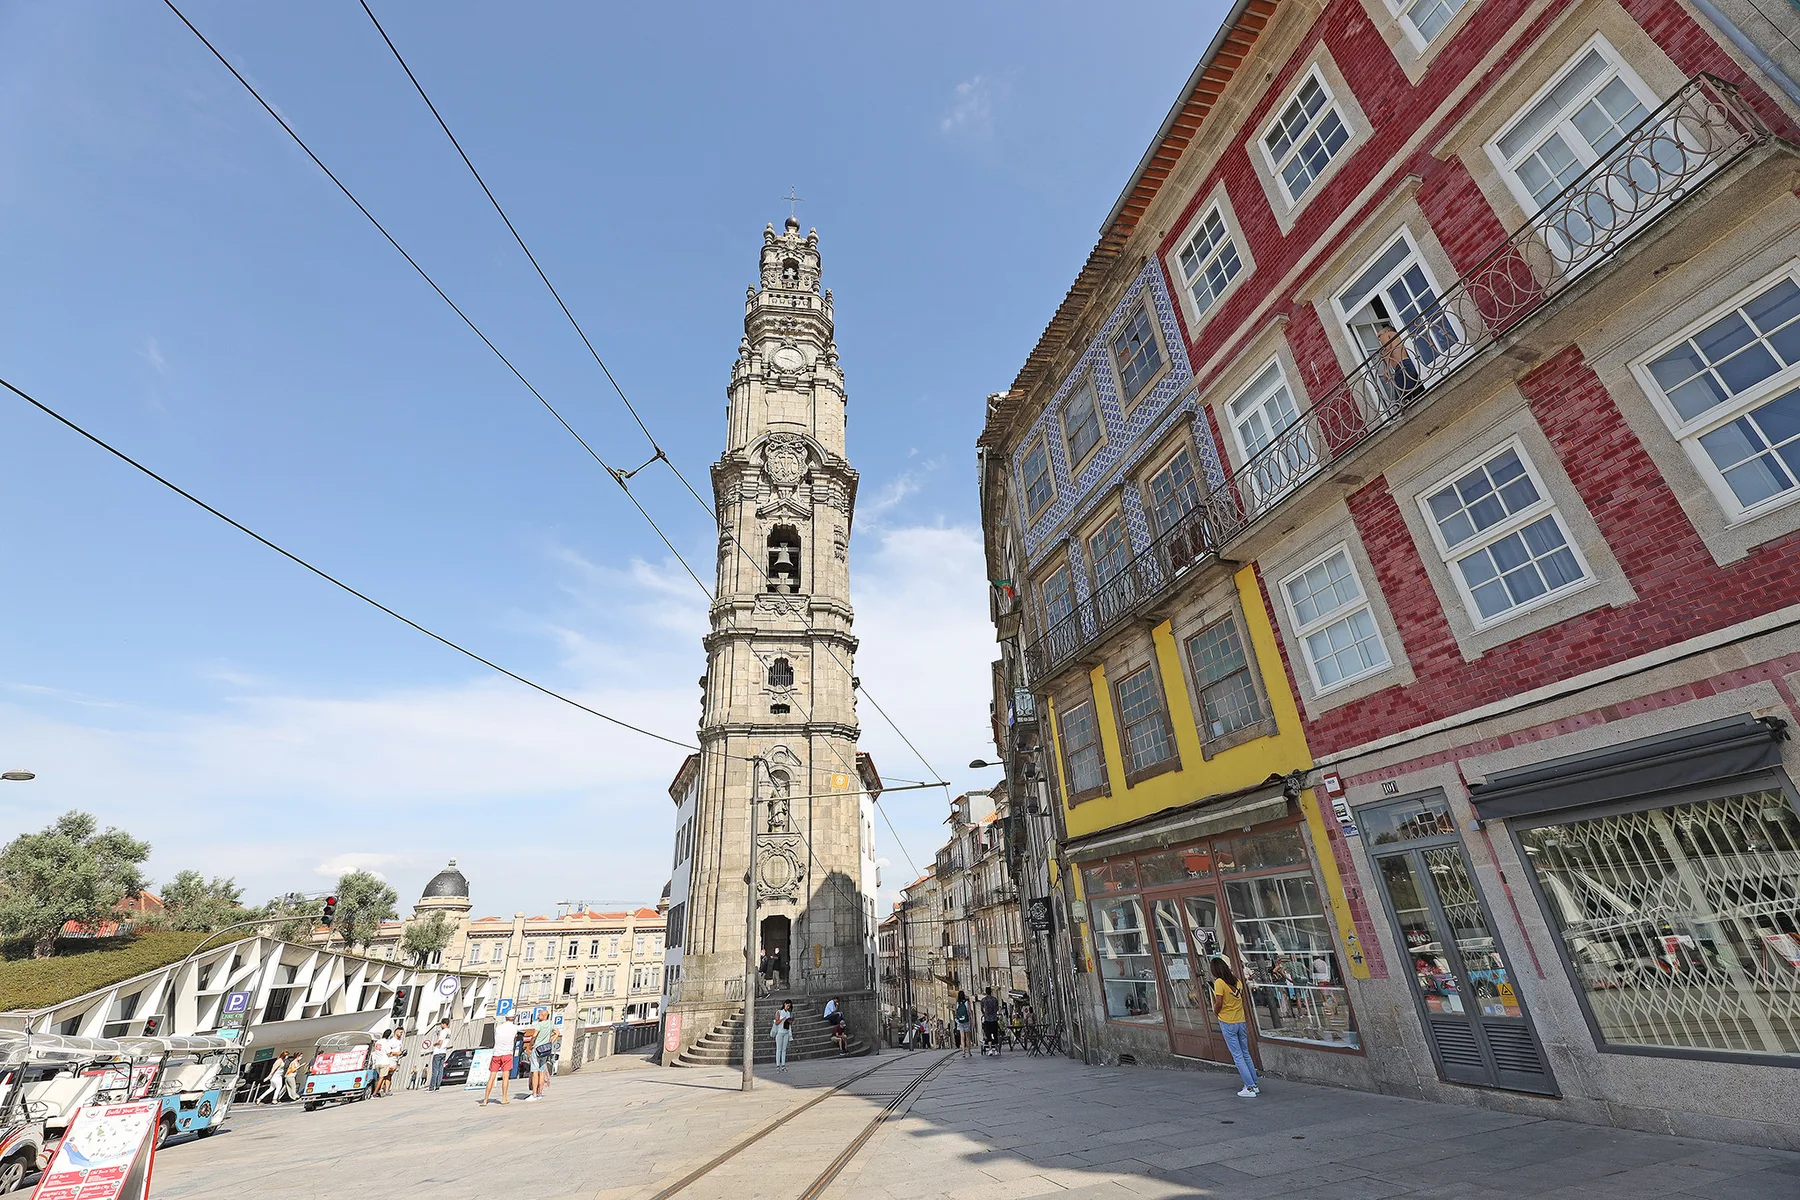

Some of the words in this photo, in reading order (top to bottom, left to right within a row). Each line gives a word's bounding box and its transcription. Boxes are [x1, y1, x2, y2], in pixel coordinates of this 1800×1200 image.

[1383, 782, 1396, 794] 101
[229, 995, 243, 1011] P
[499, 1000, 509, 1014] P
